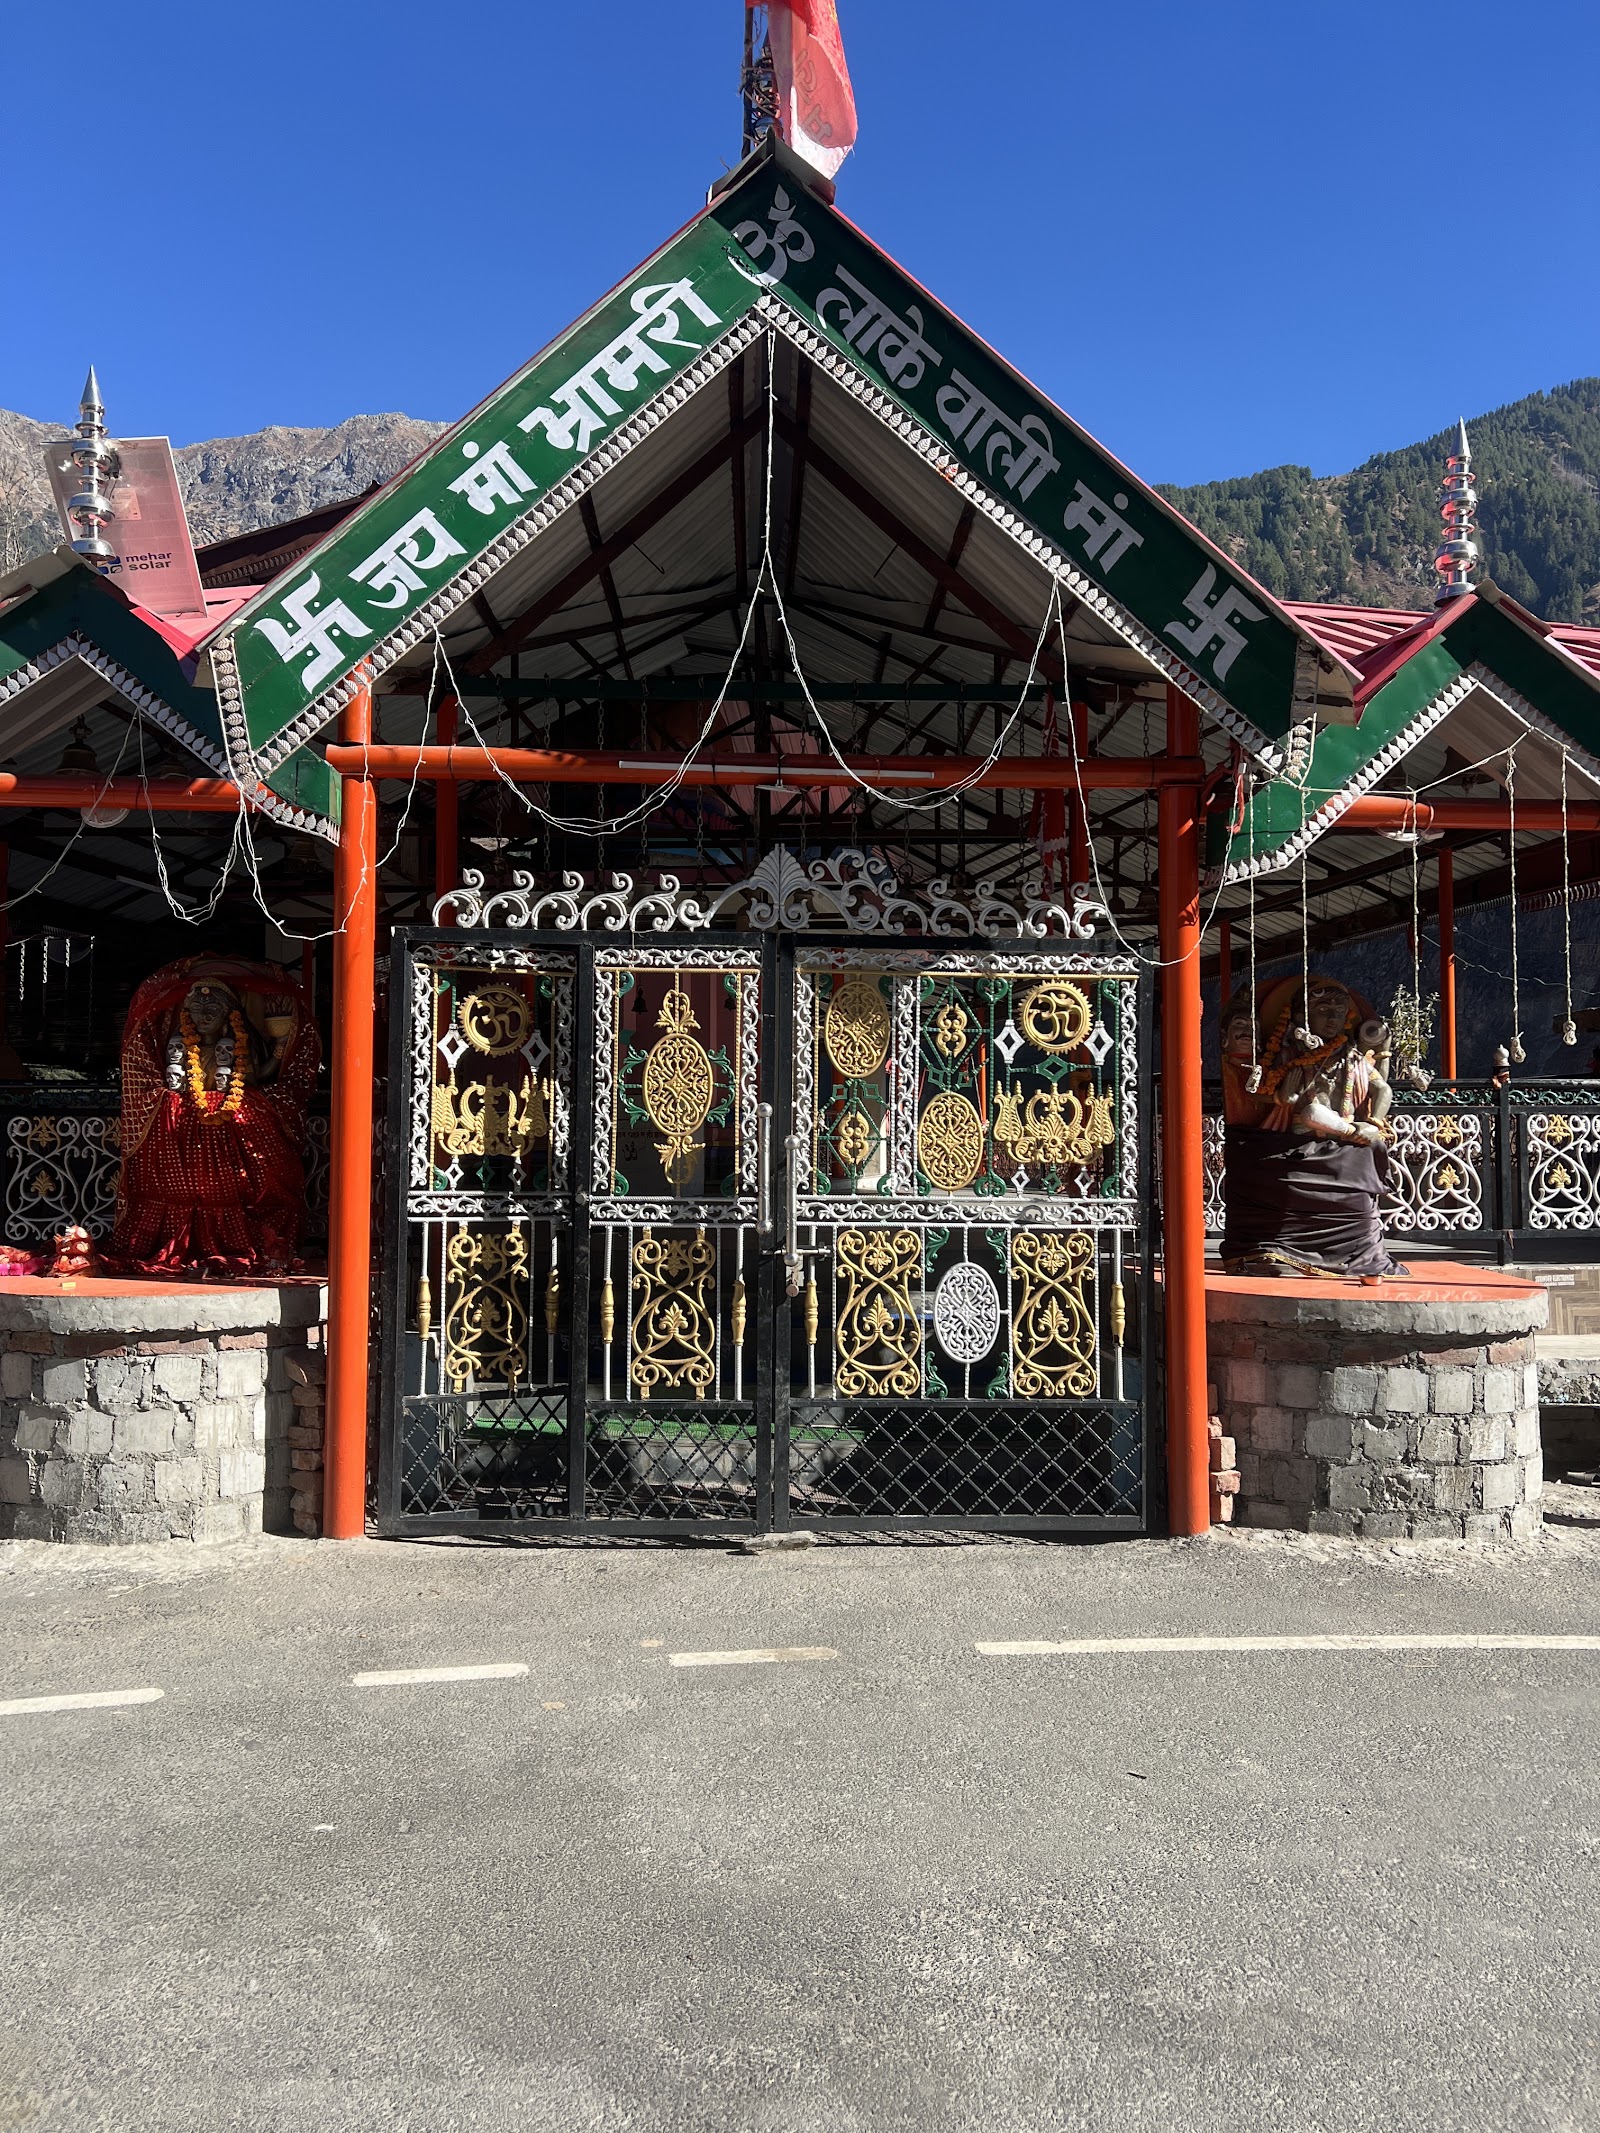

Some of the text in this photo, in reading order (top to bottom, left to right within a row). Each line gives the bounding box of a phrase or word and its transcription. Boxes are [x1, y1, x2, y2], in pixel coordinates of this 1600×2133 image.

[348, 277, 723, 609] जय मां भ्रामरी
[816, 263, 943, 390] लाके
[936, 368, 1061, 503] वाली
[1063, 480, 1145, 575] मां
[125, 552, 172, 563] mehar
[128, 560, 172, 572] solar
